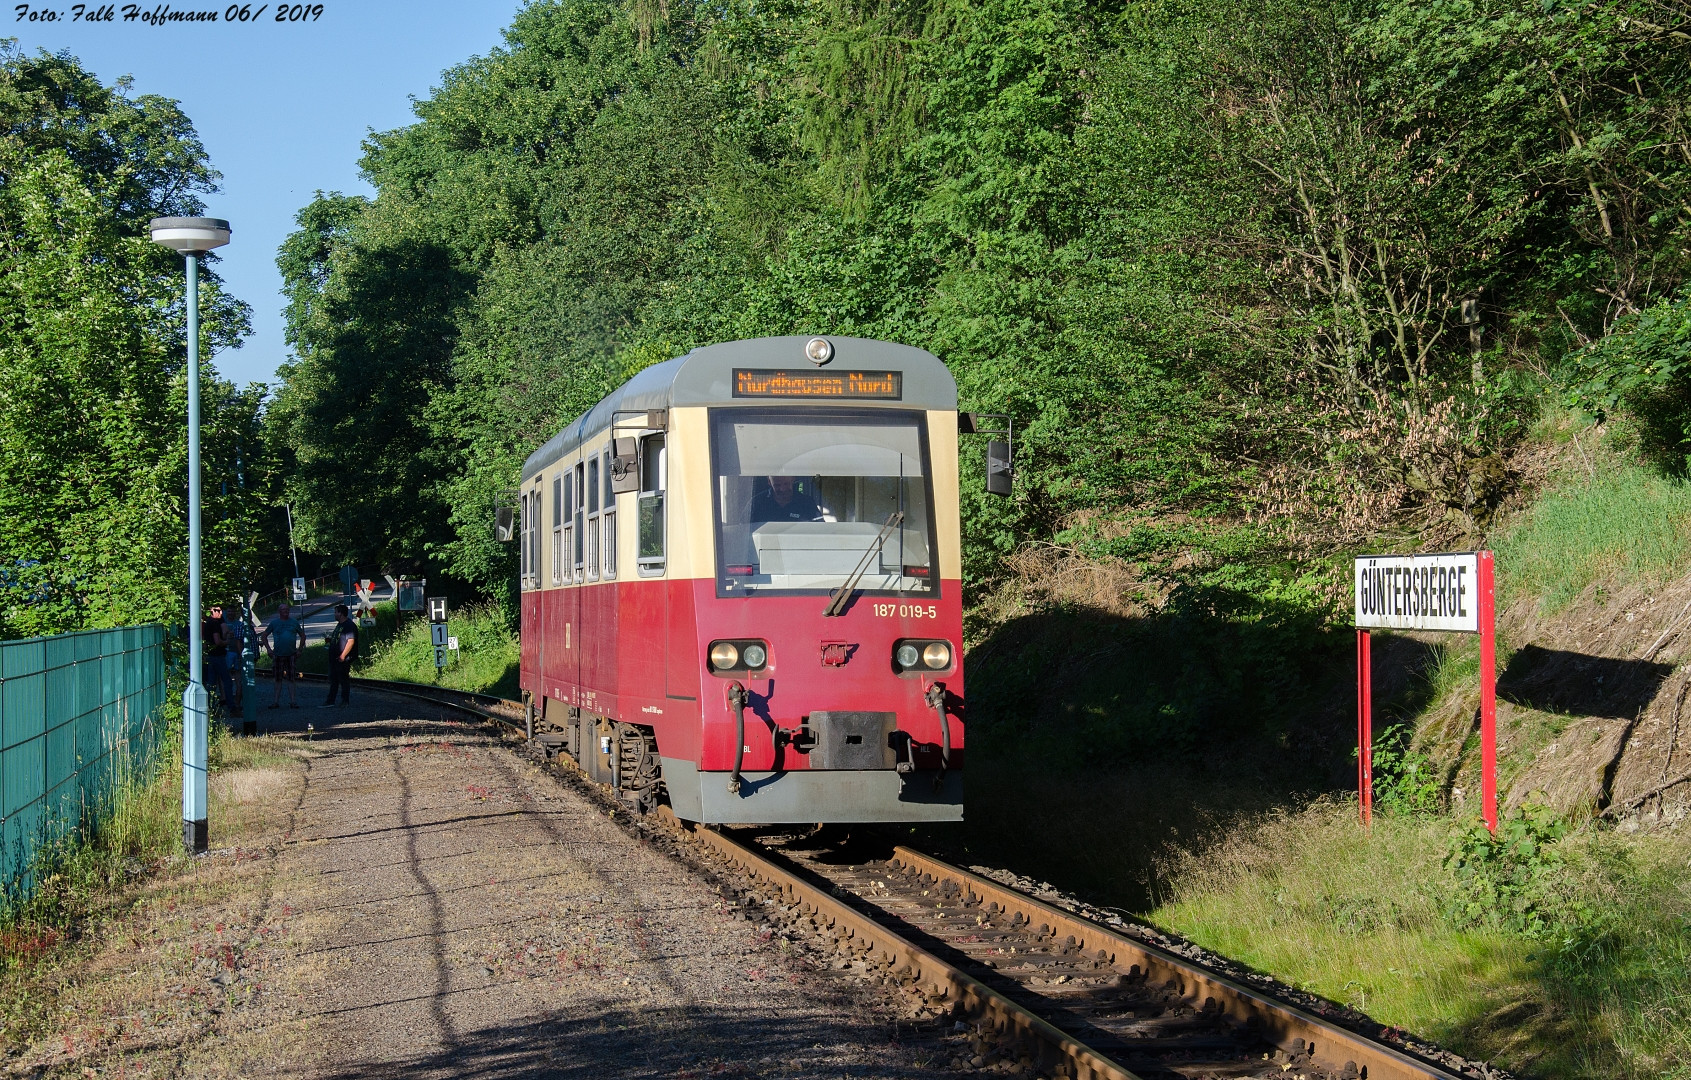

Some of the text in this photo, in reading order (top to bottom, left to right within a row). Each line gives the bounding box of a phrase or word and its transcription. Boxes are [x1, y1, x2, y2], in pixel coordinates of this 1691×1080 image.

[849, 372, 893, 393] Nord
[296, 580, 303, 592] 4
[1361, 559, 1467, 617] GÜNTERSBERGE
[431, 600, 446, 621] H
[873, 603, 937, 619] 187 019-5
[436, 626, 443, 643] 1
